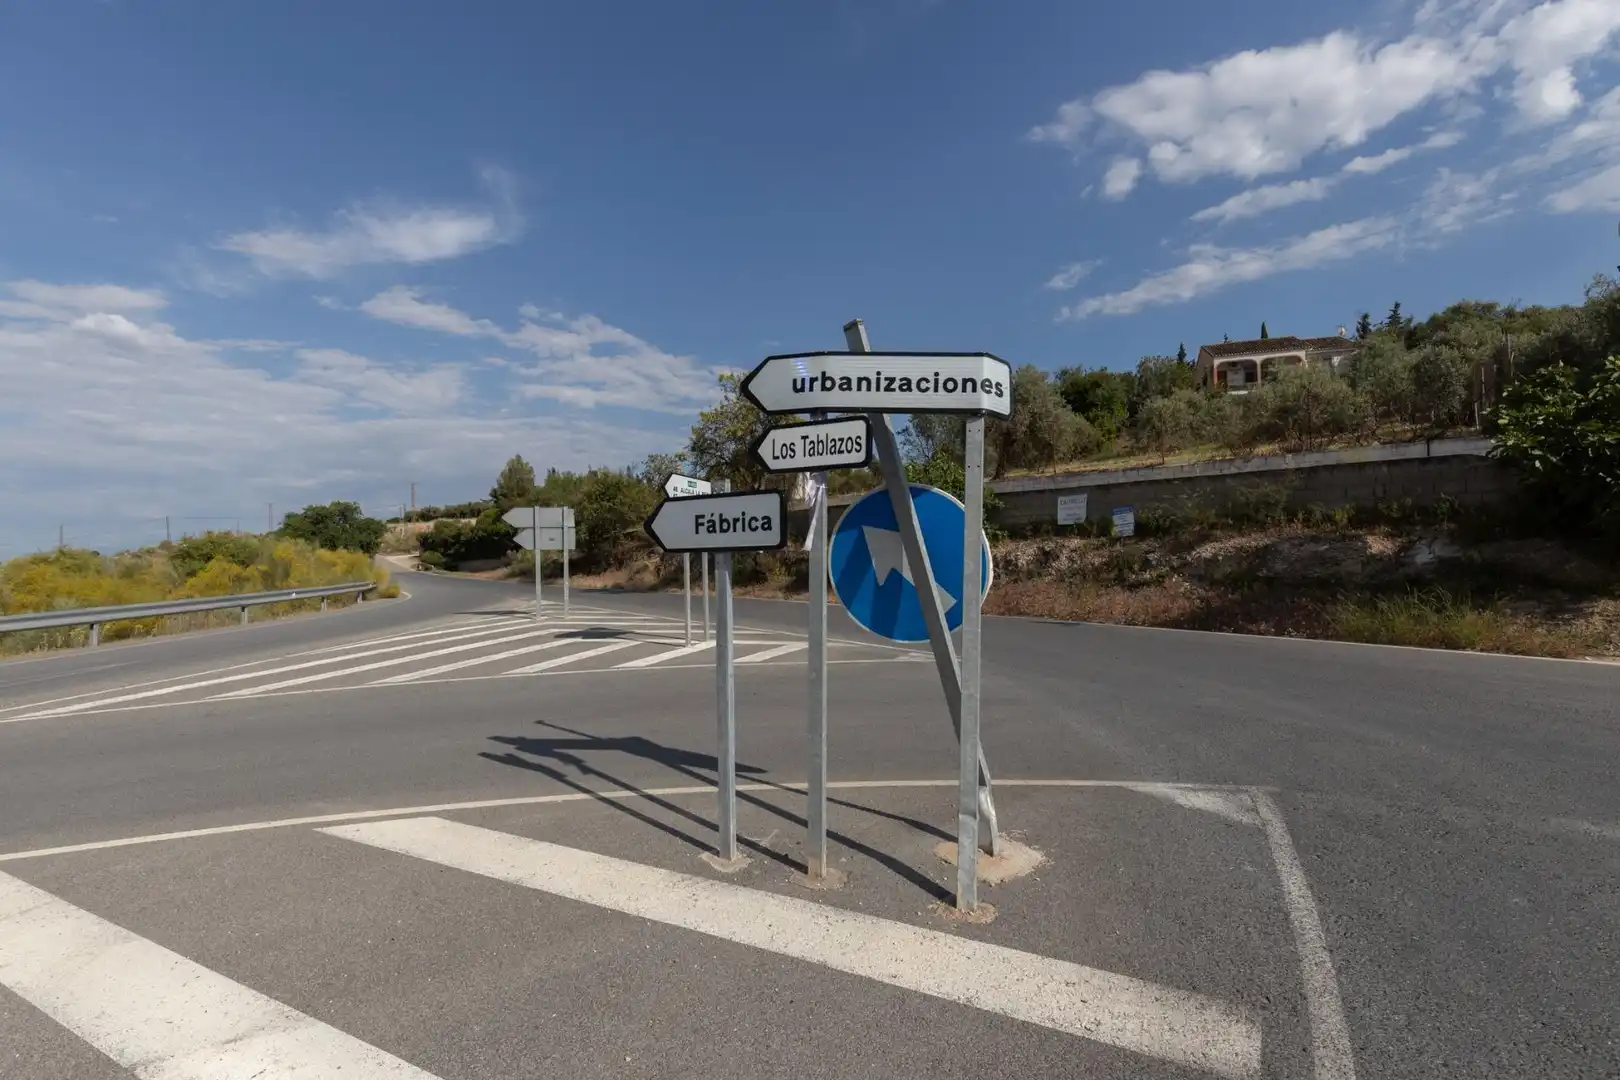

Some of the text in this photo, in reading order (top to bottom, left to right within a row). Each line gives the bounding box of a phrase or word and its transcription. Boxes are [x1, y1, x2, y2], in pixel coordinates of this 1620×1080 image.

[792, 370, 1004, 399] urbanizaciones
[772, 432, 863, 460] Los Tablazos
[694, 510, 773, 535] Fábrica
